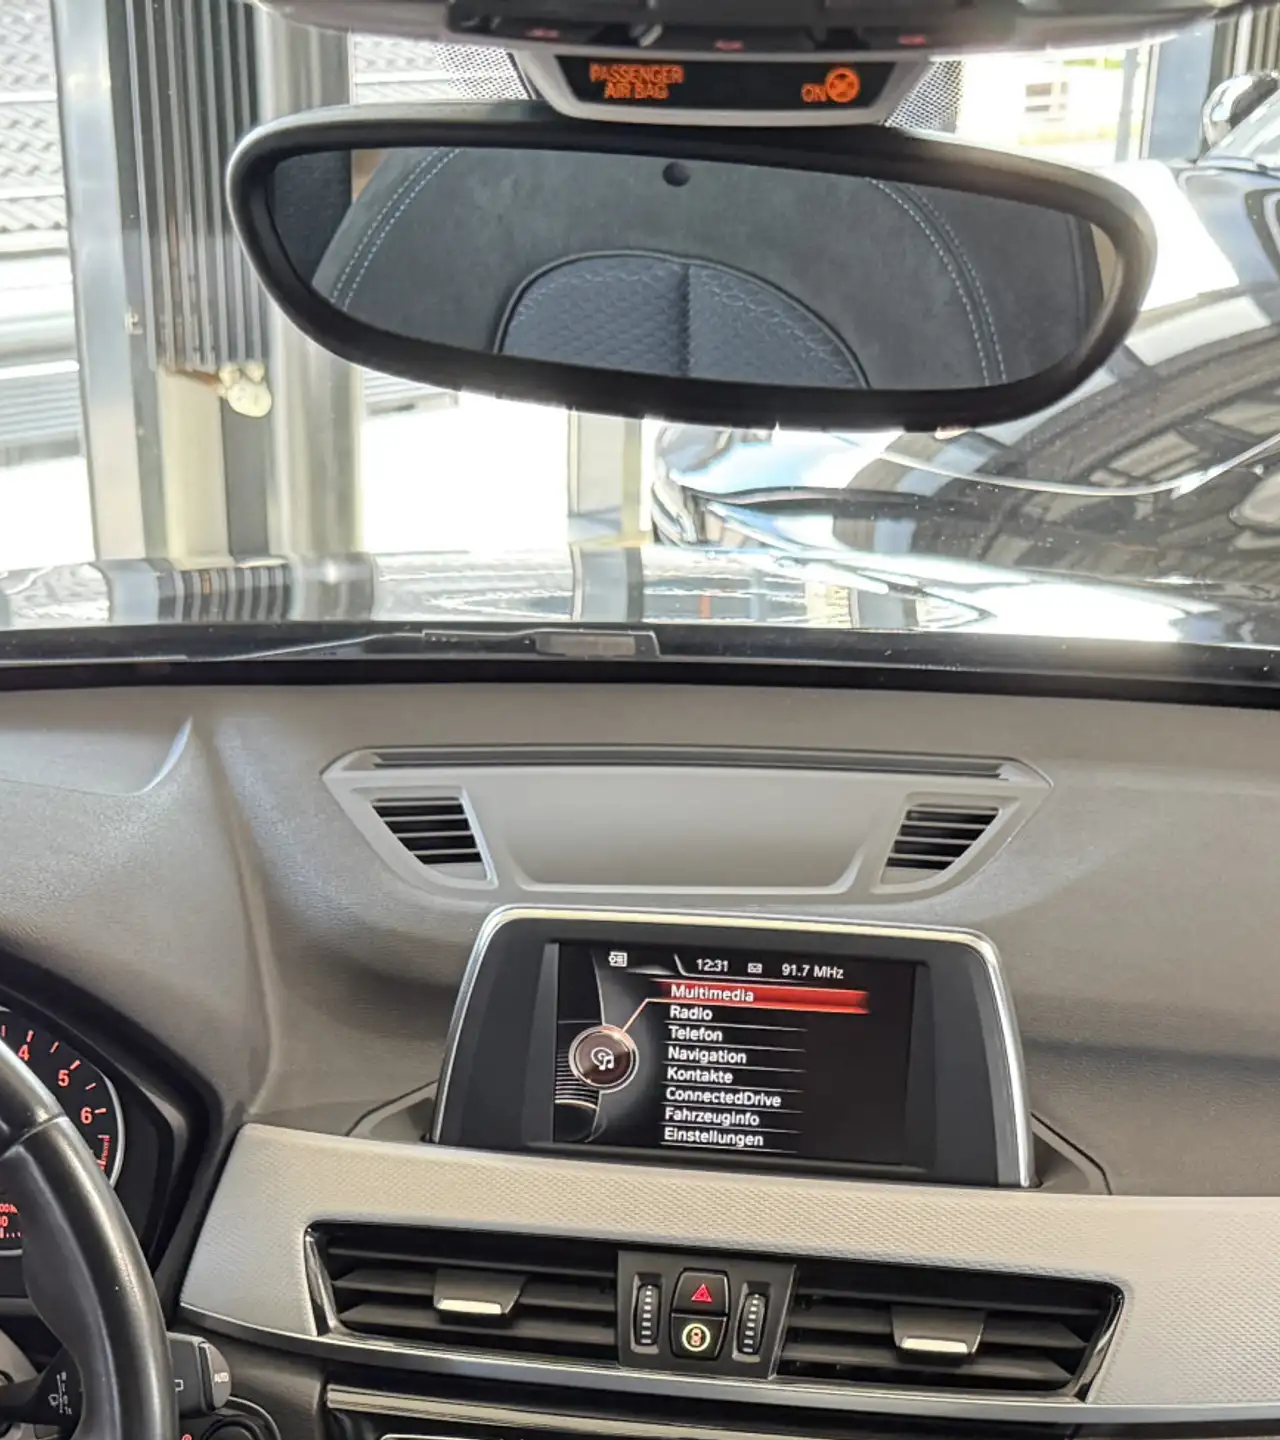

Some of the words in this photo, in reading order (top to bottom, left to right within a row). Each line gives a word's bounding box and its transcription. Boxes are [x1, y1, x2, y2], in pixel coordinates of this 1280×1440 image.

[589, 63, 685, 84] PASSENGER
[604, 82, 633, 99] AIR
[634, 84, 669, 100] BAG
[801, 83, 827, 103] ON
[695, 958, 729, 973] 12:31
[782, 963, 810, 978] 91.7
[813, 964, 844, 979] MHz
[670, 984, 754, 1003] Multimedia
[669, 1006, 713, 1021] Radio
[668, 1025, 723, 1042] Telefon
[18, 1045, 30, 1061] 4
[667, 1046, 747, 1065] Navigation
[57, 1070, 70, 1087] 5
[666, 1066, 733, 1084] Kontakte
[665, 1086, 782, 1107] ConnectedDrive
[80, 1107, 93, 1124] 6
[664, 1107, 760, 1127] Fahrzeuginfo
[664, 1127, 764, 1147] Einstellungen
